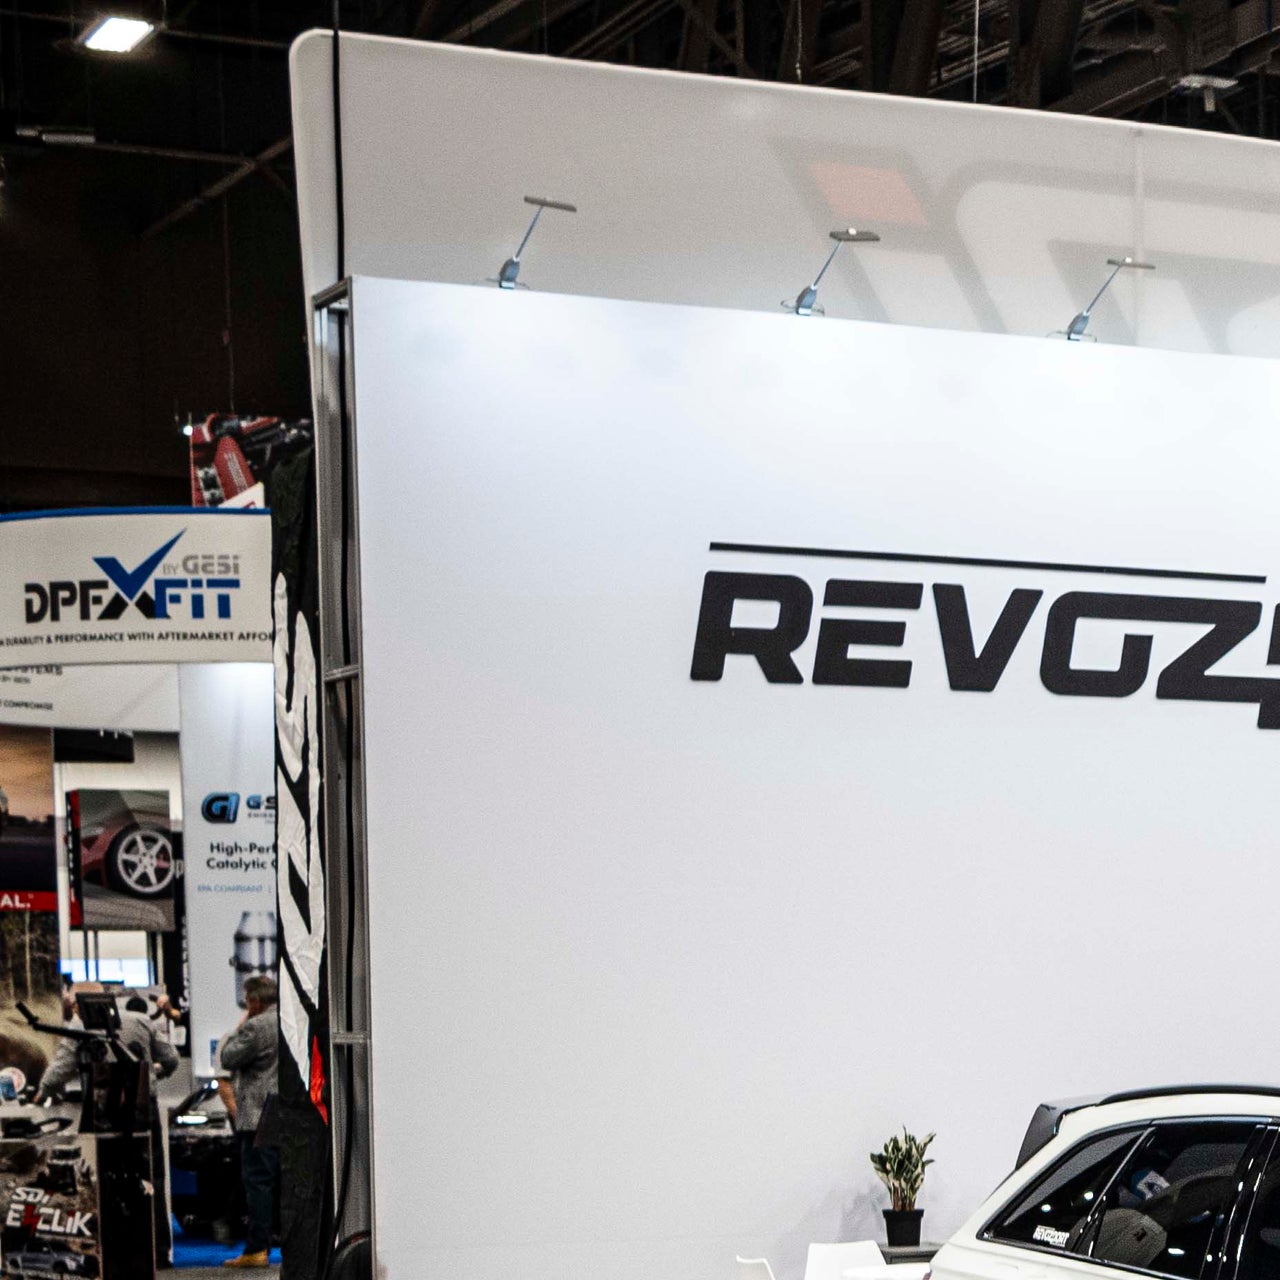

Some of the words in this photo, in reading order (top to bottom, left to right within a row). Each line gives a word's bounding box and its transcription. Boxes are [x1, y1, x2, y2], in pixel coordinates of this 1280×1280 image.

[55, 633, 124, 643] PERFORMANCE
[128, 633, 155, 641] WITH
[157, 632, 234, 642] AFTERMARKET
[206, 858, 267, 872] Catalytic
